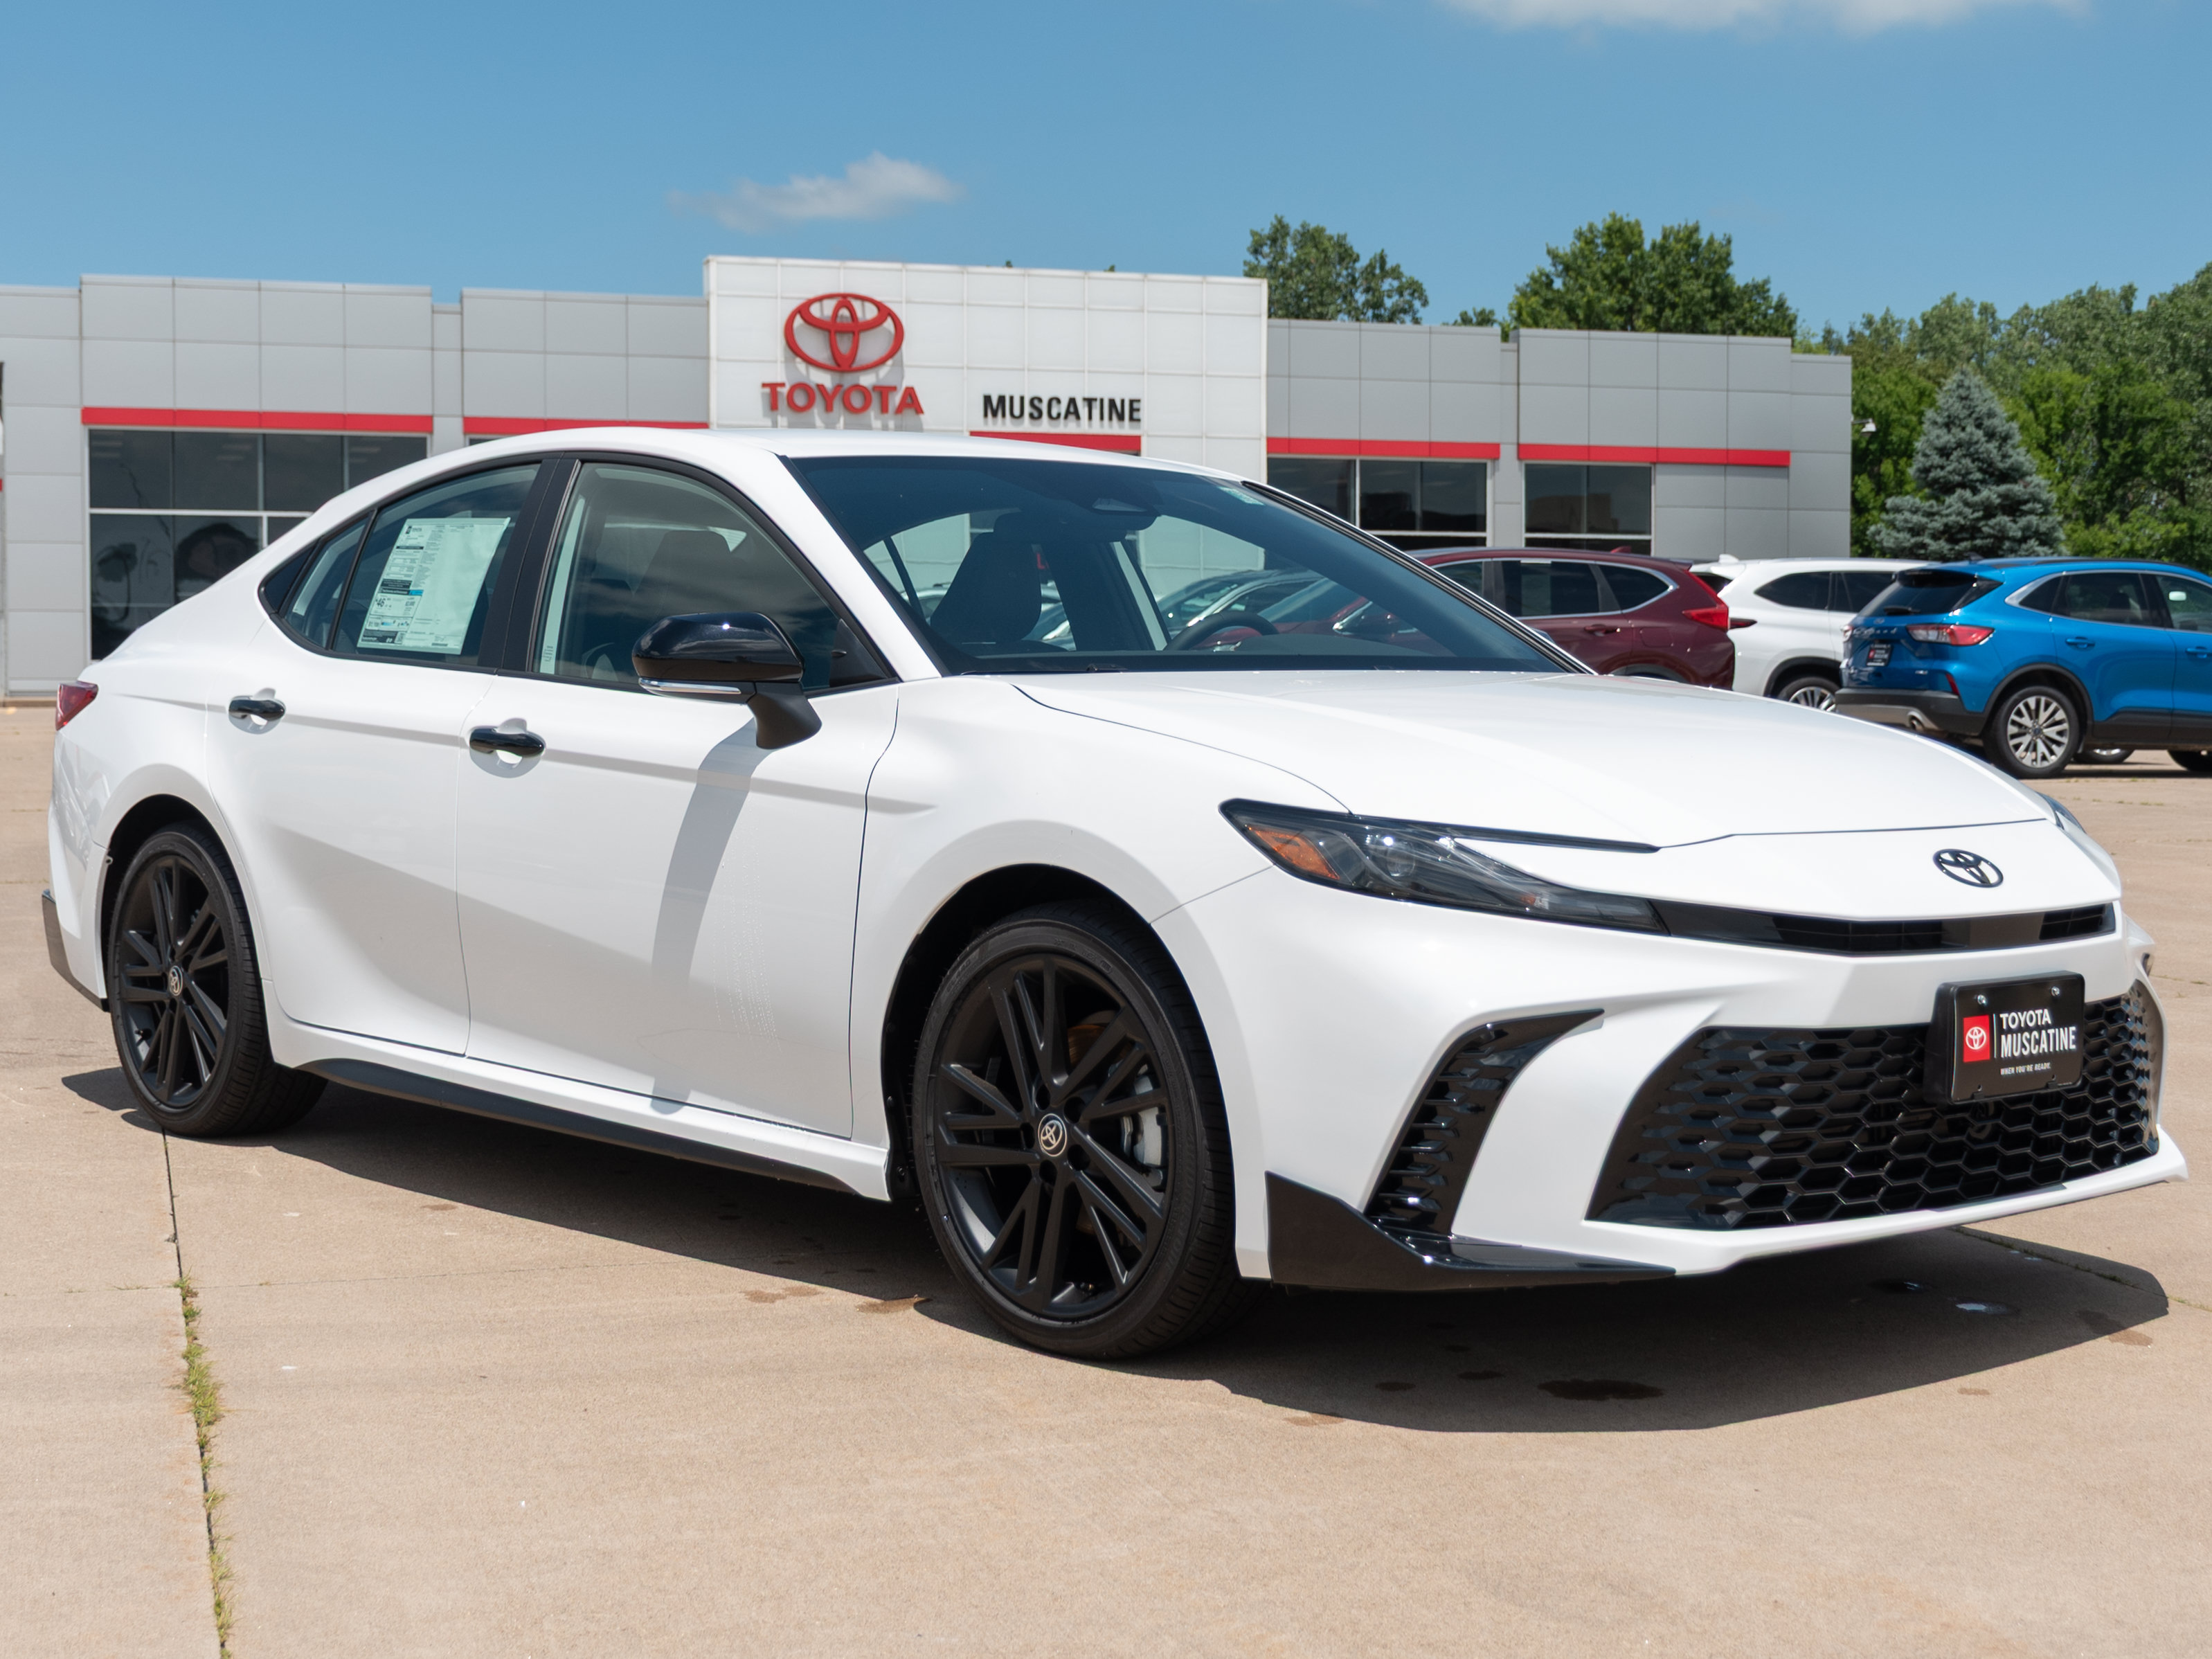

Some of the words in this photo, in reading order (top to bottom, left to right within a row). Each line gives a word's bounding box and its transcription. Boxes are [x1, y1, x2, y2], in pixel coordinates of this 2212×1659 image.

[762, 382, 924, 415] TOYOTA
[983, 395, 1141, 422] MUSCATINE
[1999, 1008, 2051, 1030] TOYOTA
[2000, 1026, 2076, 1059] MUSCATINE
[2000, 1067, 2015, 1075] WHEN
